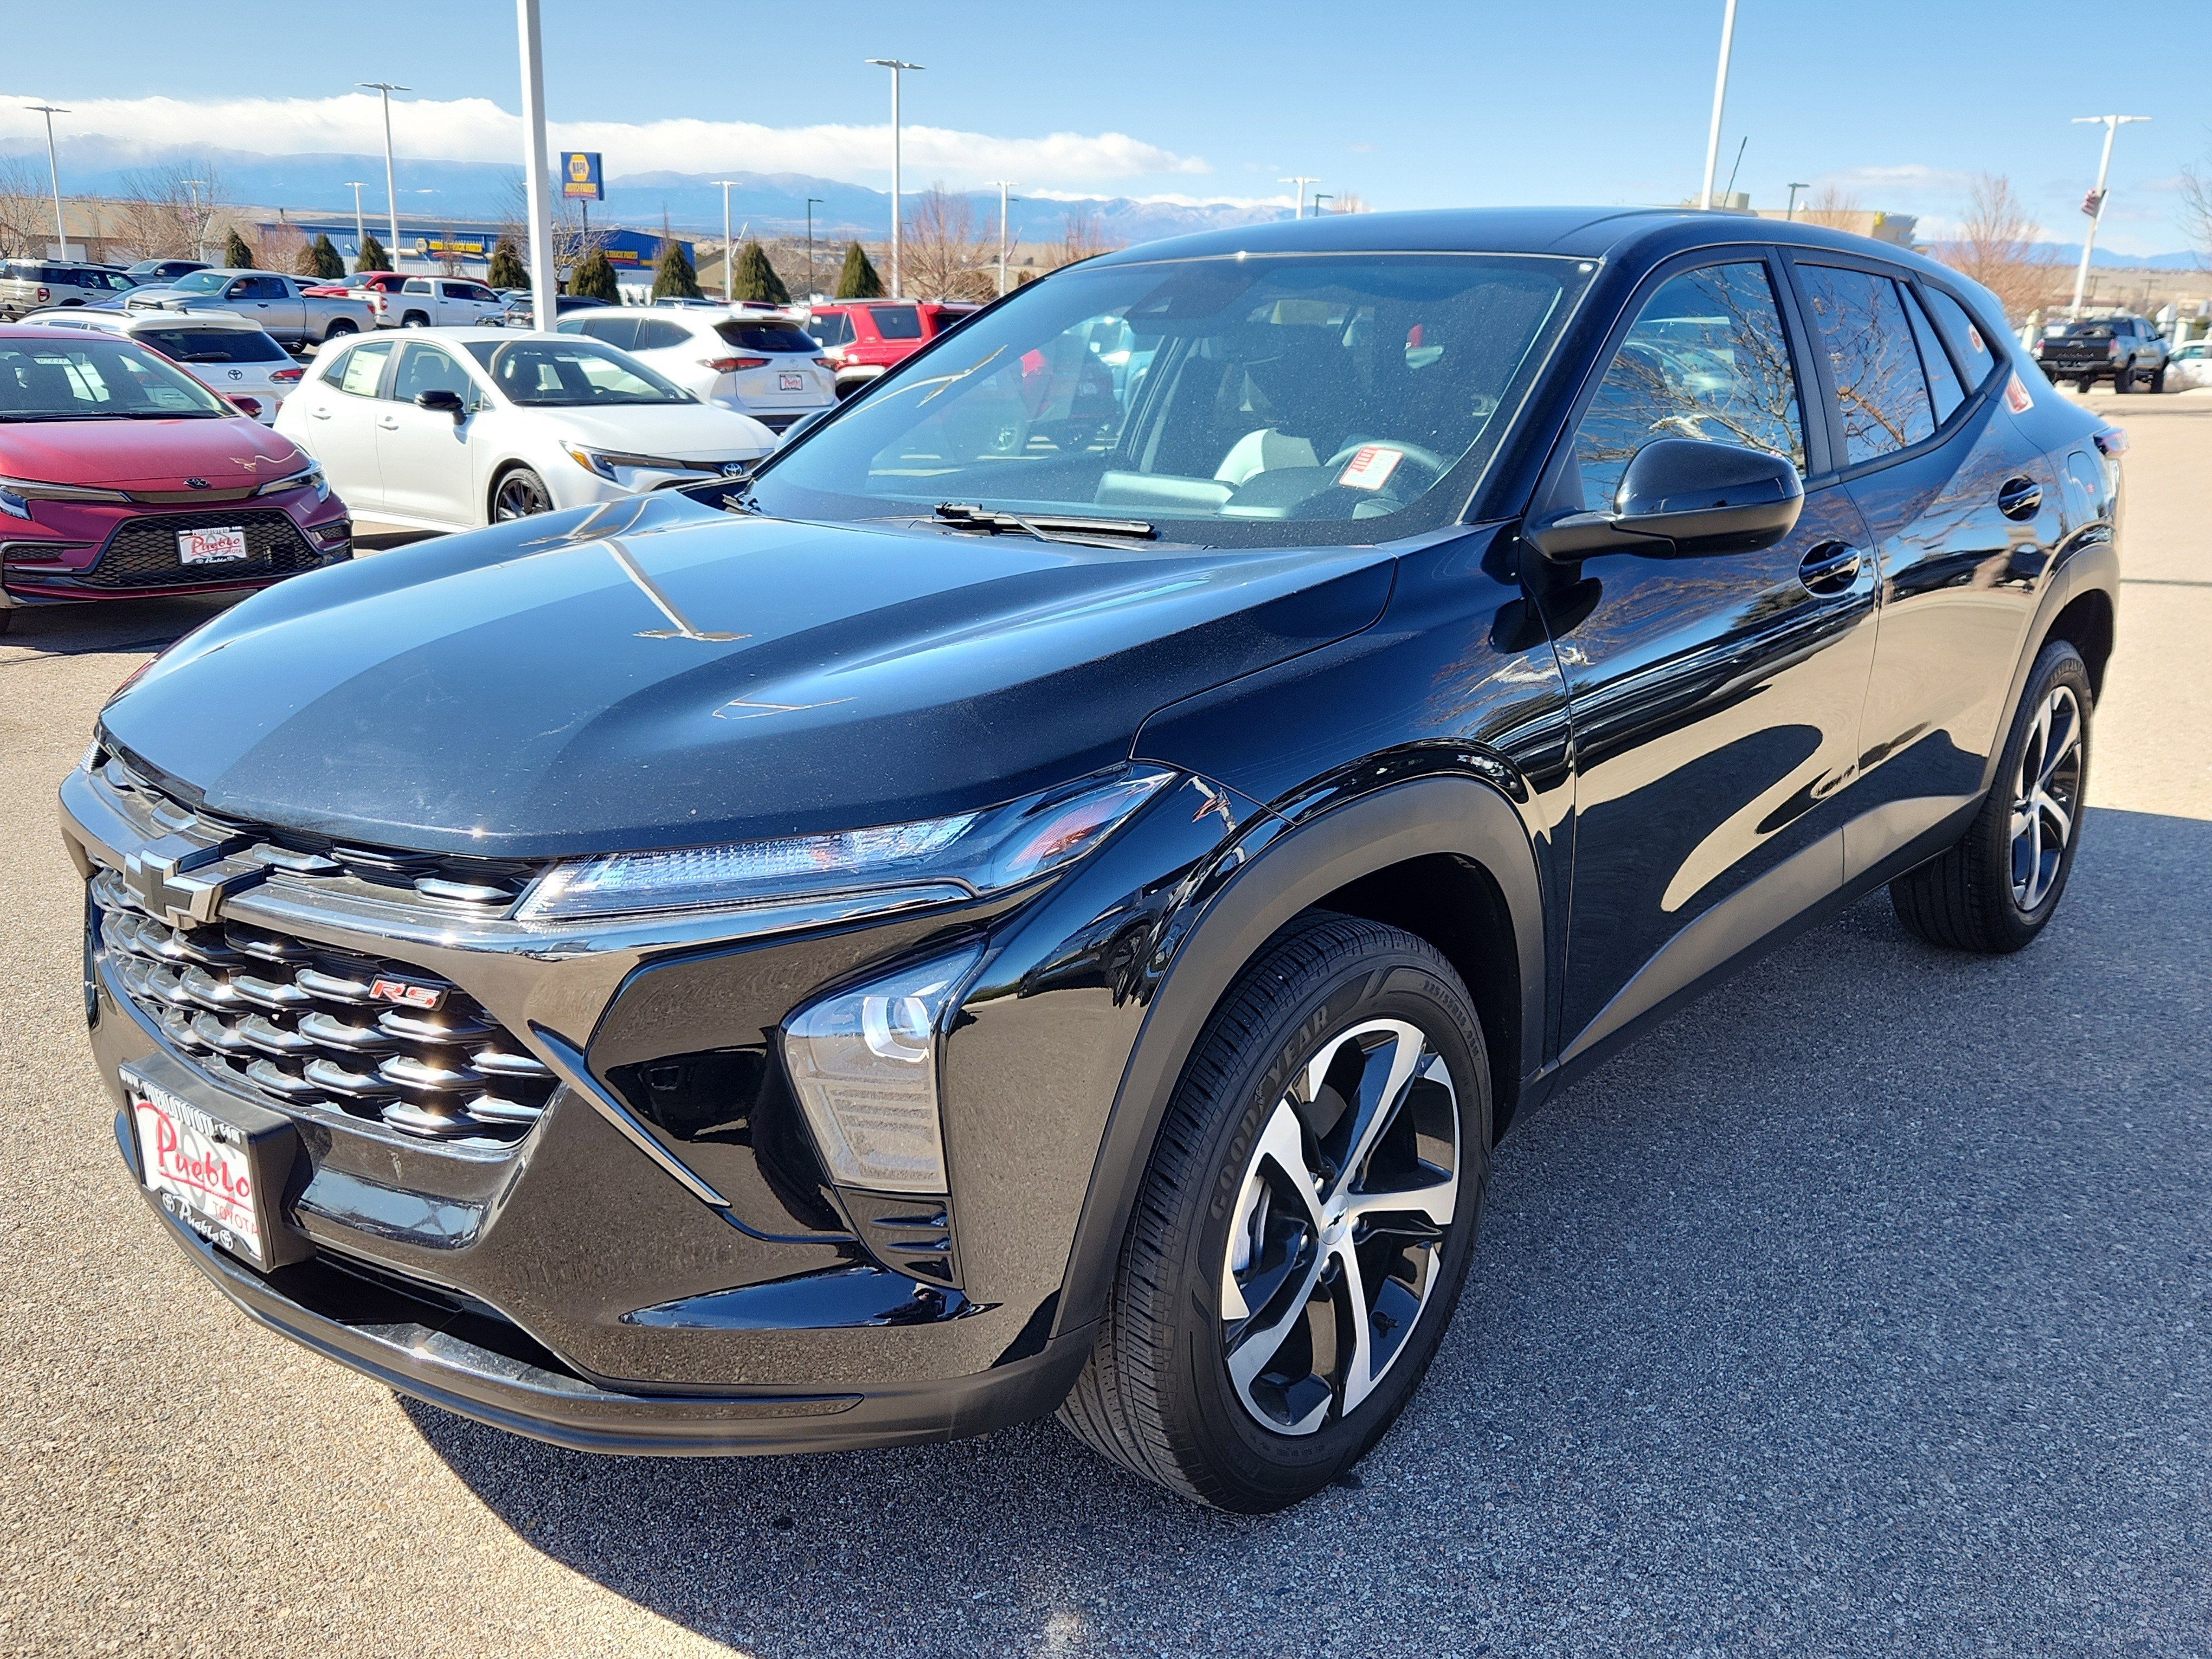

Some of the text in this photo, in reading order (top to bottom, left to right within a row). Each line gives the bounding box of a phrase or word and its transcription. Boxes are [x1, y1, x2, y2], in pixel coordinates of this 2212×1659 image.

[572, 162, 586, 174] NAPA
[181, 535, 240, 554] Pueblo
[369, 979, 440, 1009] RS
[1211, 1004, 1327, 1220] GOODYEAR
[136, 1102, 250, 1197] Pueblo
[173, 1194, 220, 1242] Pueblo
[213, 1200, 259, 1234] TOYOTA
